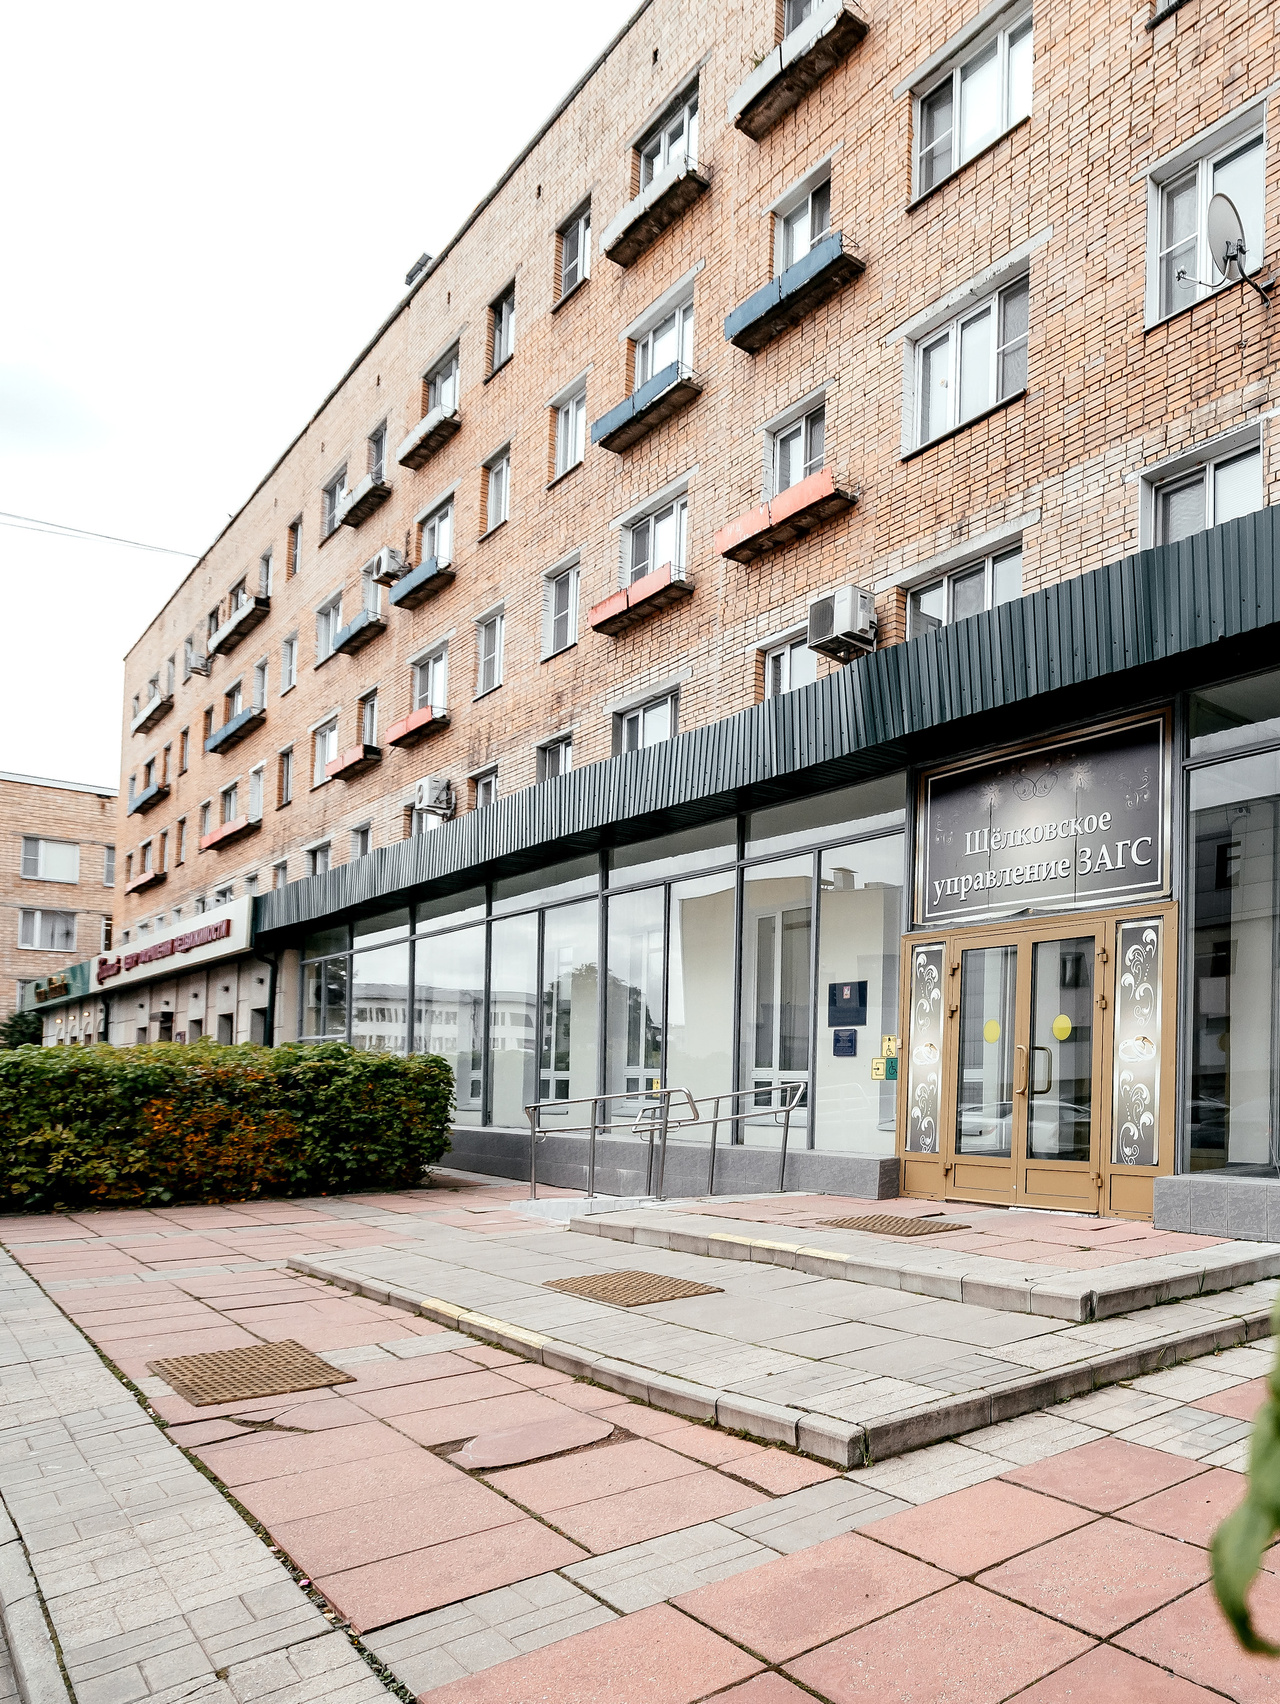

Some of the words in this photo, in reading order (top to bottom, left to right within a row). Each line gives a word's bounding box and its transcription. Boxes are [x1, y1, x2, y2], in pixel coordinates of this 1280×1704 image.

[963, 811, 1112, 857] Щёлковское
[933, 857, 1071, 905] управление
[1078, 837, 1152, 876] ЗАГС
